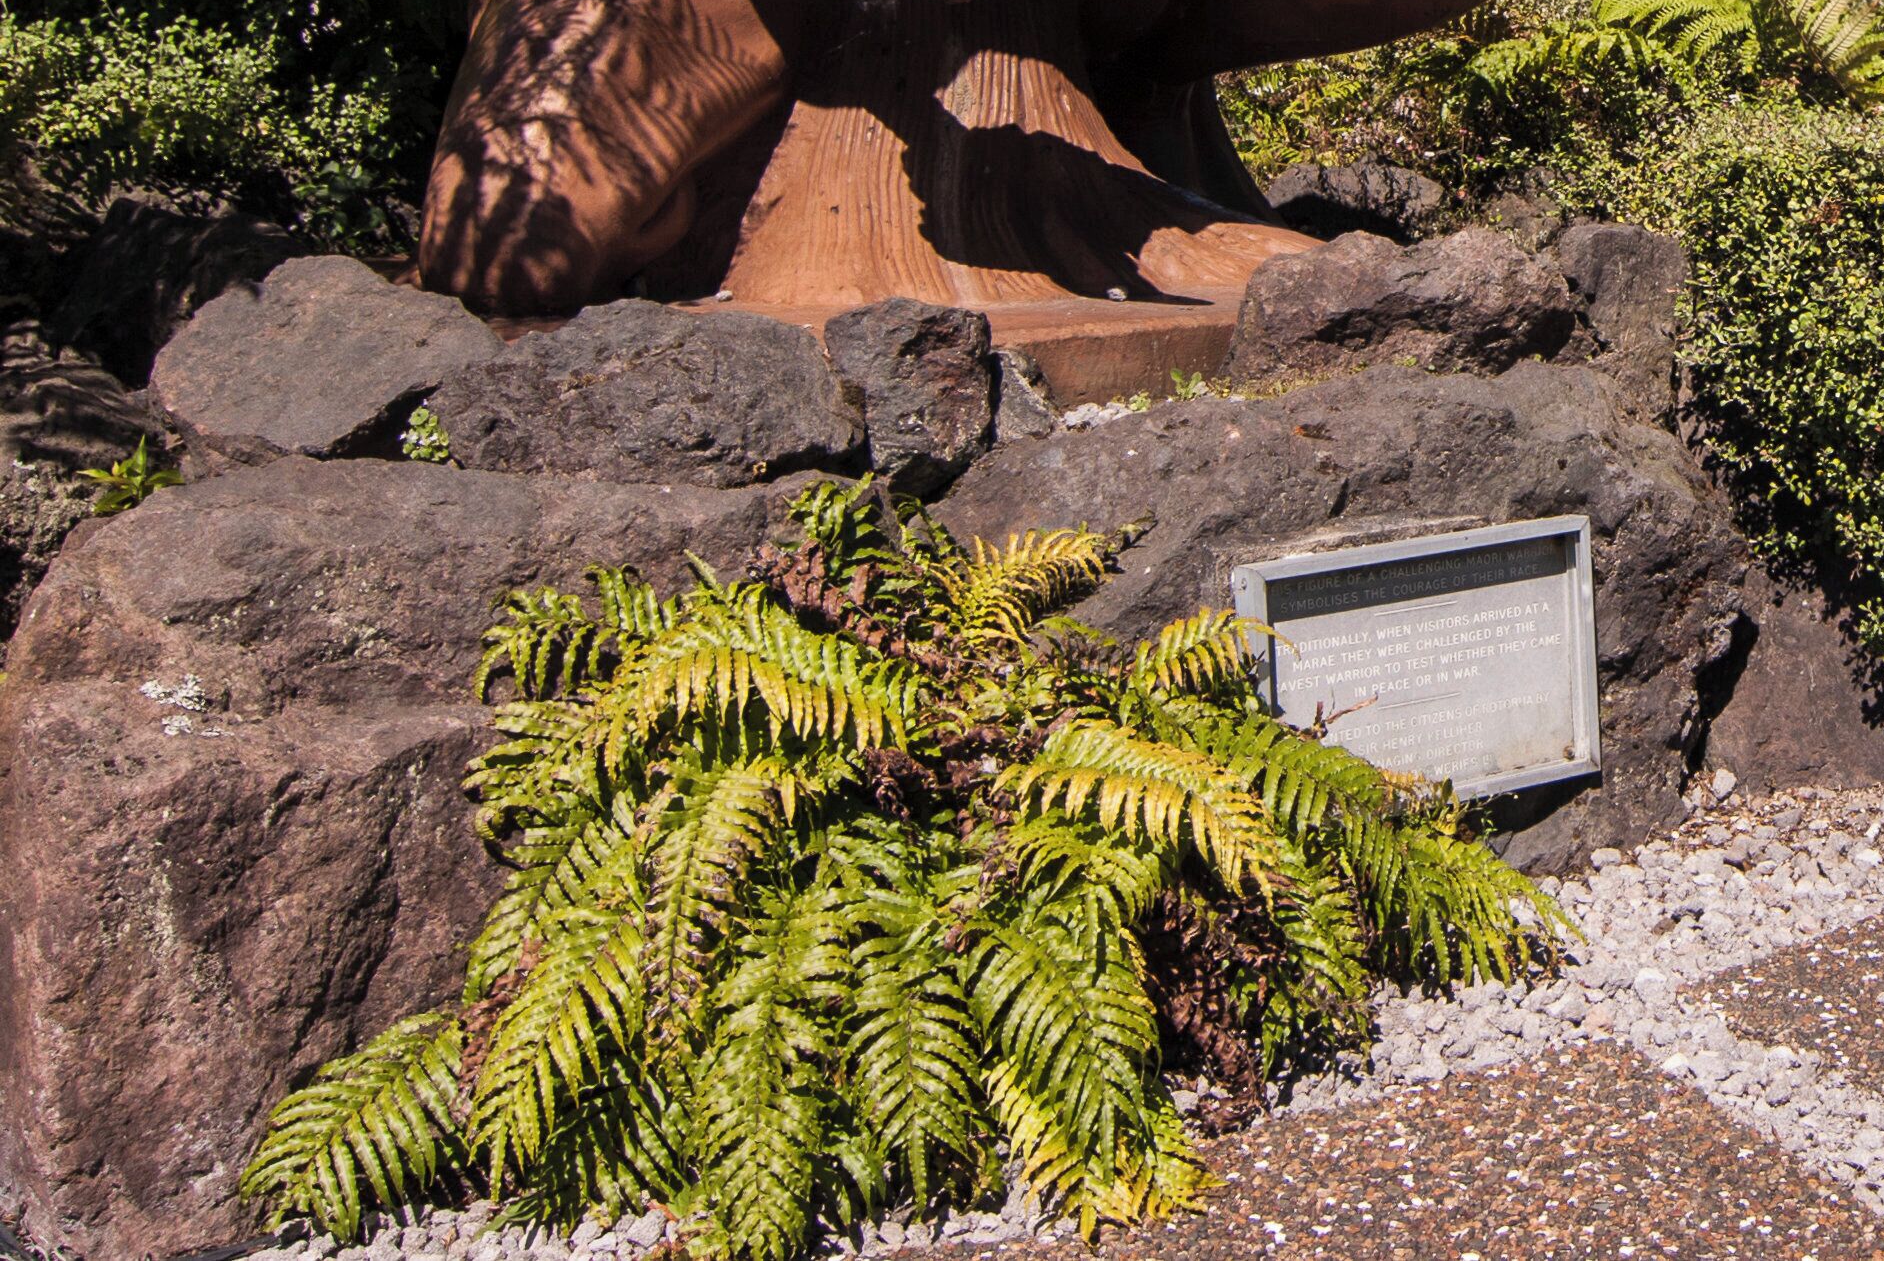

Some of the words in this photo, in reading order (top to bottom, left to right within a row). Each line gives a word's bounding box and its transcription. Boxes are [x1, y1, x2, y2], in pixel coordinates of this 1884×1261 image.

[1271, 583, 1291, 596] HIS
[1297, 575, 1341, 592] FIGURE
[1346, 572, 1361, 585] OF
[1367, 570, 1376, 582] A
[1380, 558, 1461, 580] CHALLENGING
[1466, 552, 1502, 569] MAORI
[1280, 592, 1358, 613] SYMBOLISES
[1364, 587, 1386, 600] THE
[1393, 578, 1447, 597] COURAGE
[1452, 574, 1467, 586] OF
[1472, 569, 1504, 584] THEIR
[1377, 626, 1412, 640] WHEN
[1416, 617, 1470, 633] VISITORS
[1473, 608, 1521, 624] ARRIVED
[1525, 604, 1540, 616] AT
[1541, 602, 1550, 612] A
[1278, 676, 1320, 693] AVEST
[1326, 665, 1380, 685] WARRIOR
[1384, 661, 1401, 674] TO
[1405, 656, 1435, 670] TEST
[1440, 645, 1495, 665] WHETHER
[1499, 640, 1527, 654] THEY
[1530, 633, 1562, 649] CAME
[1292, 655, 1336, 673] MARAE
[1340, 649, 1372, 664] THEY
[1377, 644, 1411, 658] WERE
[1415, 628, 1492, 651] CHALLENGED
[1496, 626, 1511, 638] BY
[1515, 621, 1536, 633] THE
[1354, 685, 1367, 698] IN
[1371, 678, 1411, 696] PEACE
[1415, 674, 1433, 687] OR
[1437, 671, 1449, 683] IN
[1365, 724, 1381, 736] TO
[1386, 718, 1406, 731] THE
[1410, 709, 1462, 728] CITIZENS
[1465, 705, 1479, 717] OF
[1536, 691, 1551, 704] BY
[1358, 742, 1377, 756] SIR
[1383, 733, 1423, 751] HENRY
[1426, 739, 1484, 760] DIRECTOR
